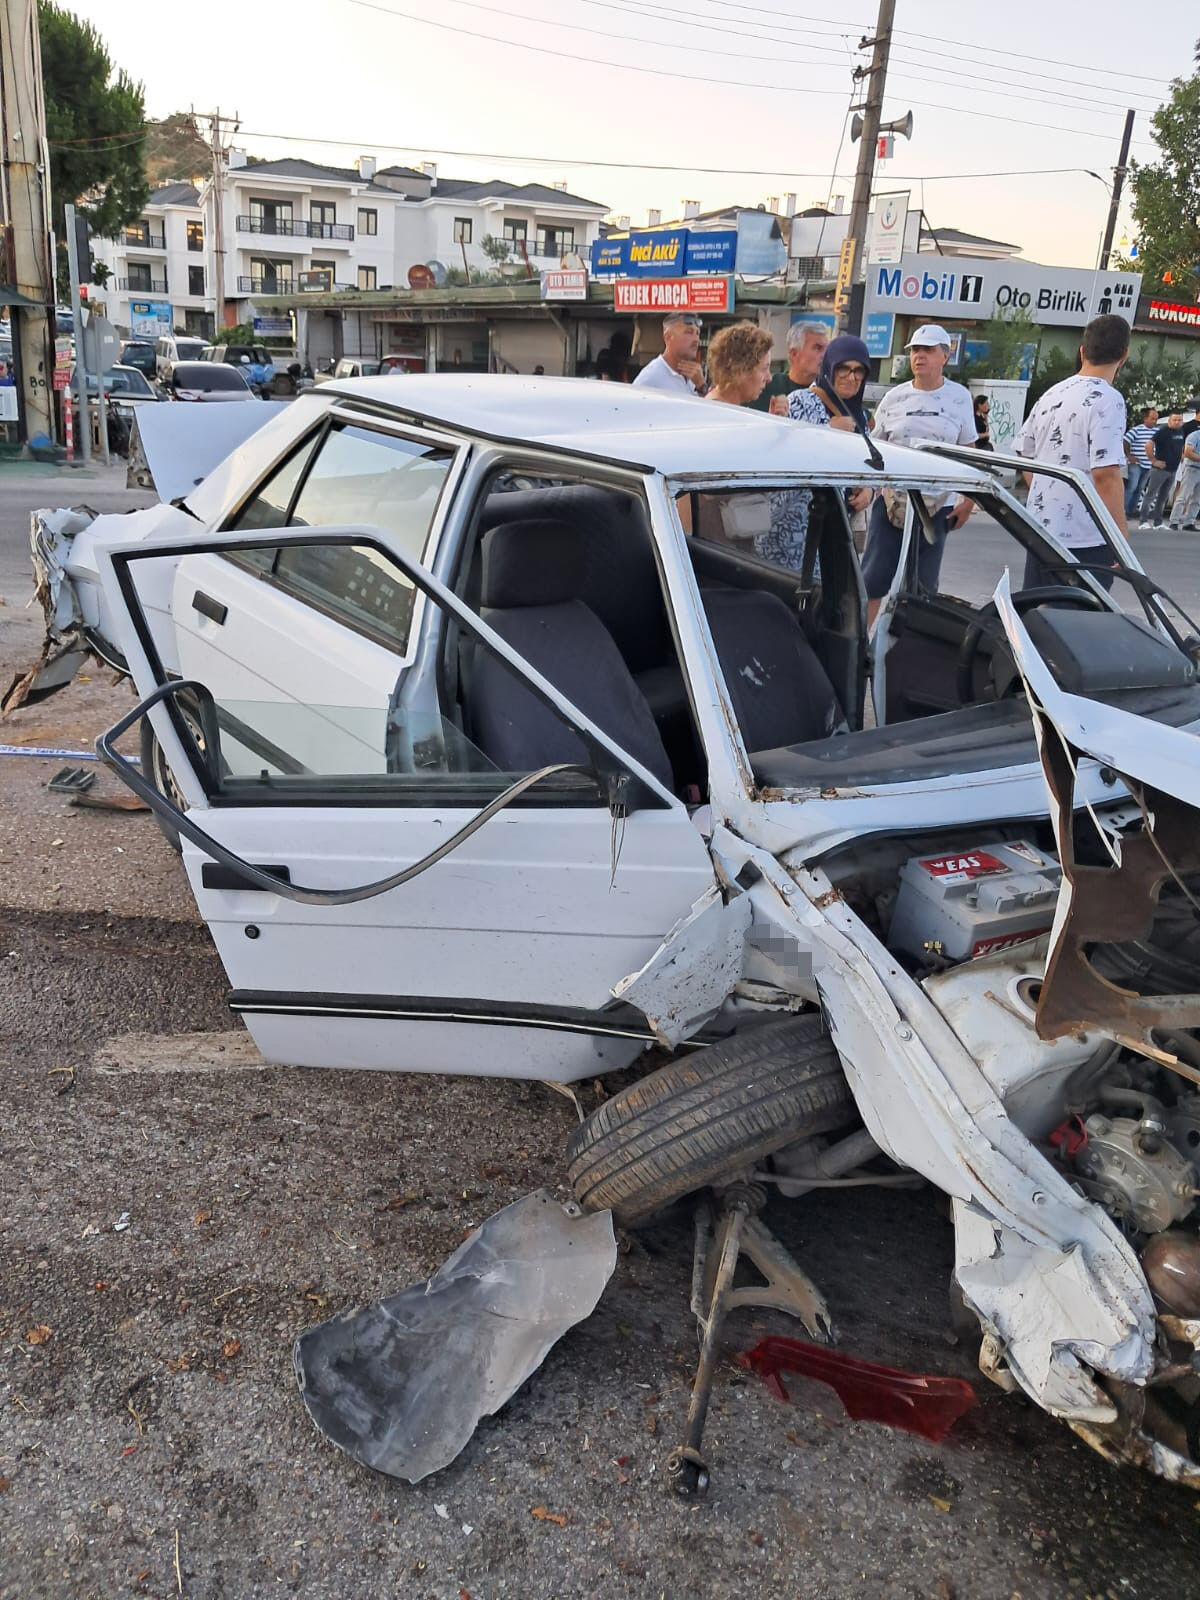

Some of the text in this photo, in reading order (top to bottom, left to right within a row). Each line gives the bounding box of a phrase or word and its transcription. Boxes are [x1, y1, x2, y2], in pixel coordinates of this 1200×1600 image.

[630, 240, 653, 262] İNCİ
[652, 238, 680, 260] AKÜ
[617, 284, 688, 308] YEDEK PARÇA
[877, 268, 955, 300] Mobil
[996, 285, 1087, 312] Oto Birlik
[946, 856, 981, 871] EAS
